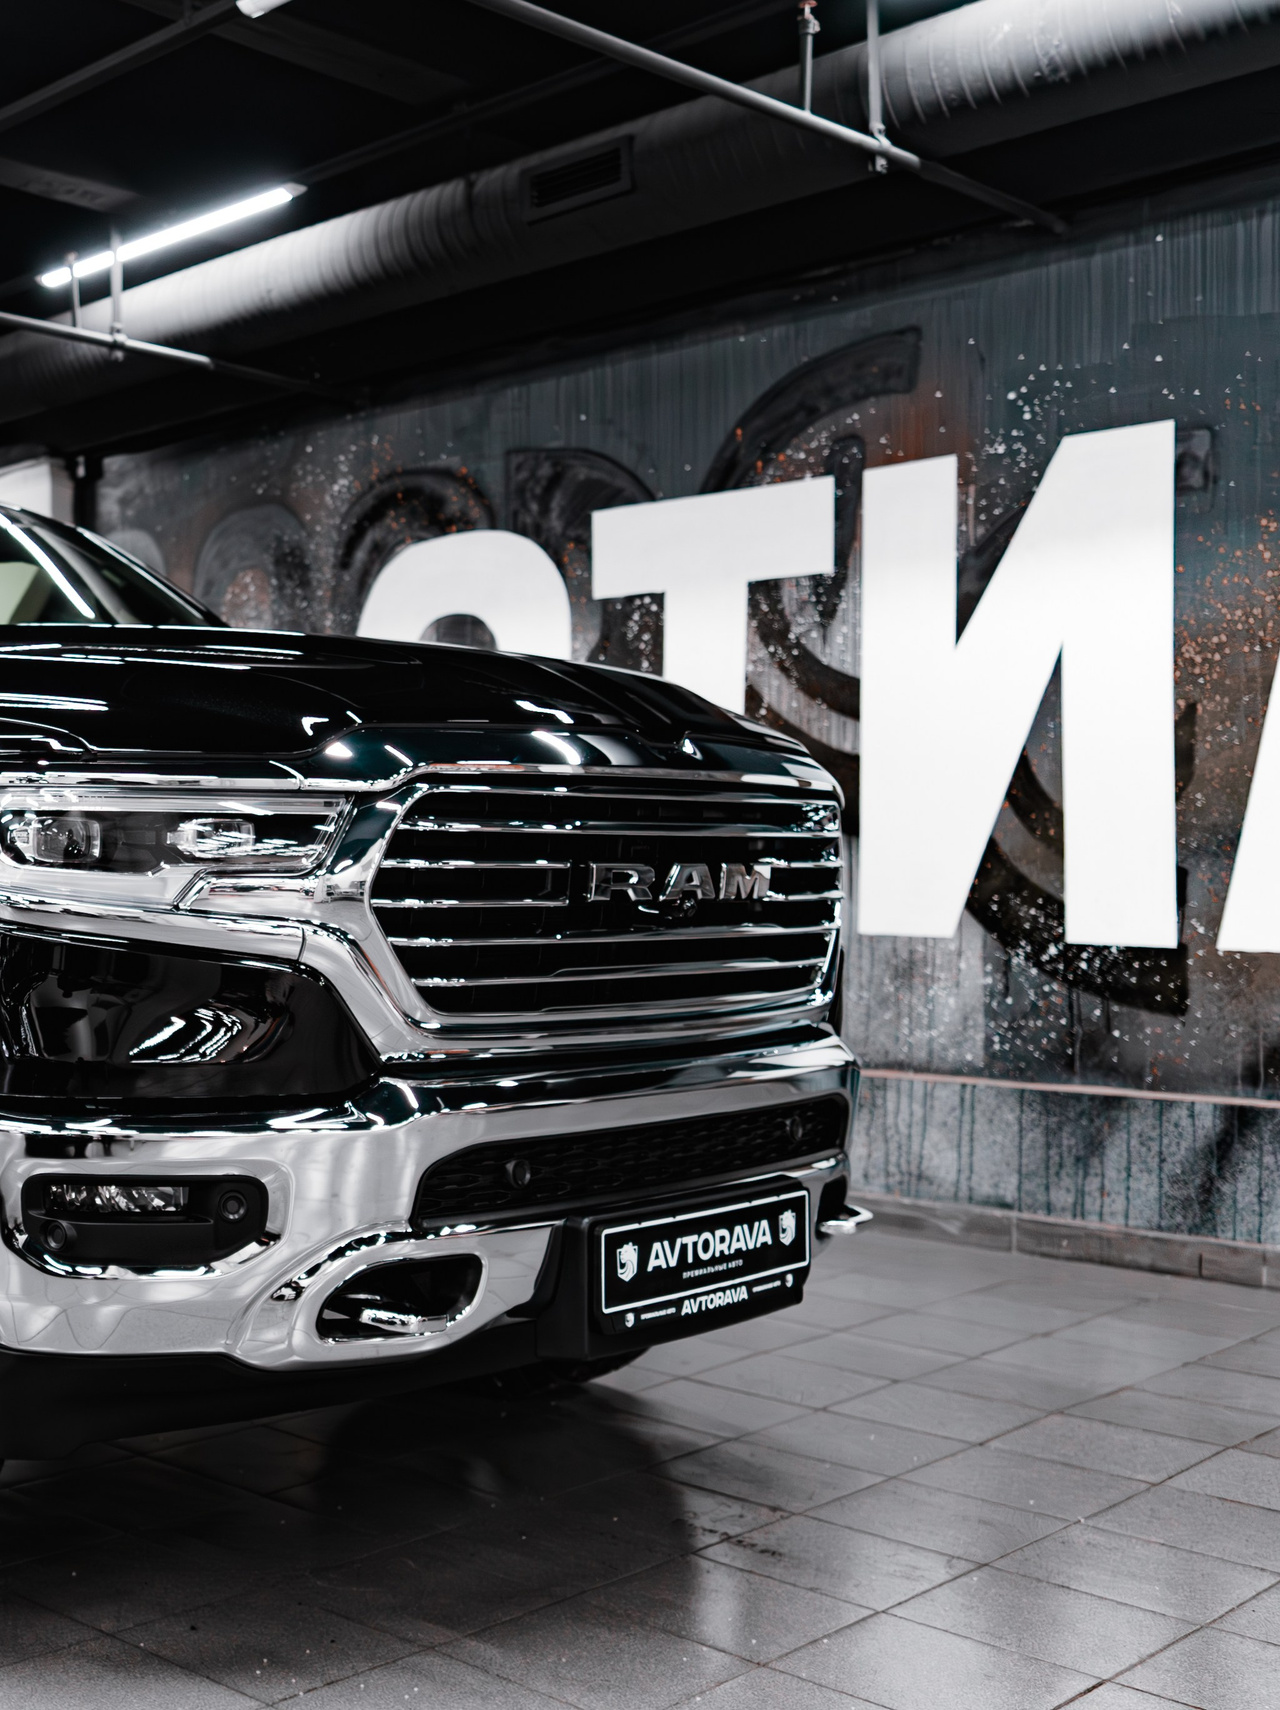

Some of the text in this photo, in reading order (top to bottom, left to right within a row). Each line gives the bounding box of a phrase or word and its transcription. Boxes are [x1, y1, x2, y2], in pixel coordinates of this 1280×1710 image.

[588, 862, 772, 902] RAM
[646, 1219, 773, 1273] AVTORAVA
[681, 1285, 749, 1317] AVTORAVA
